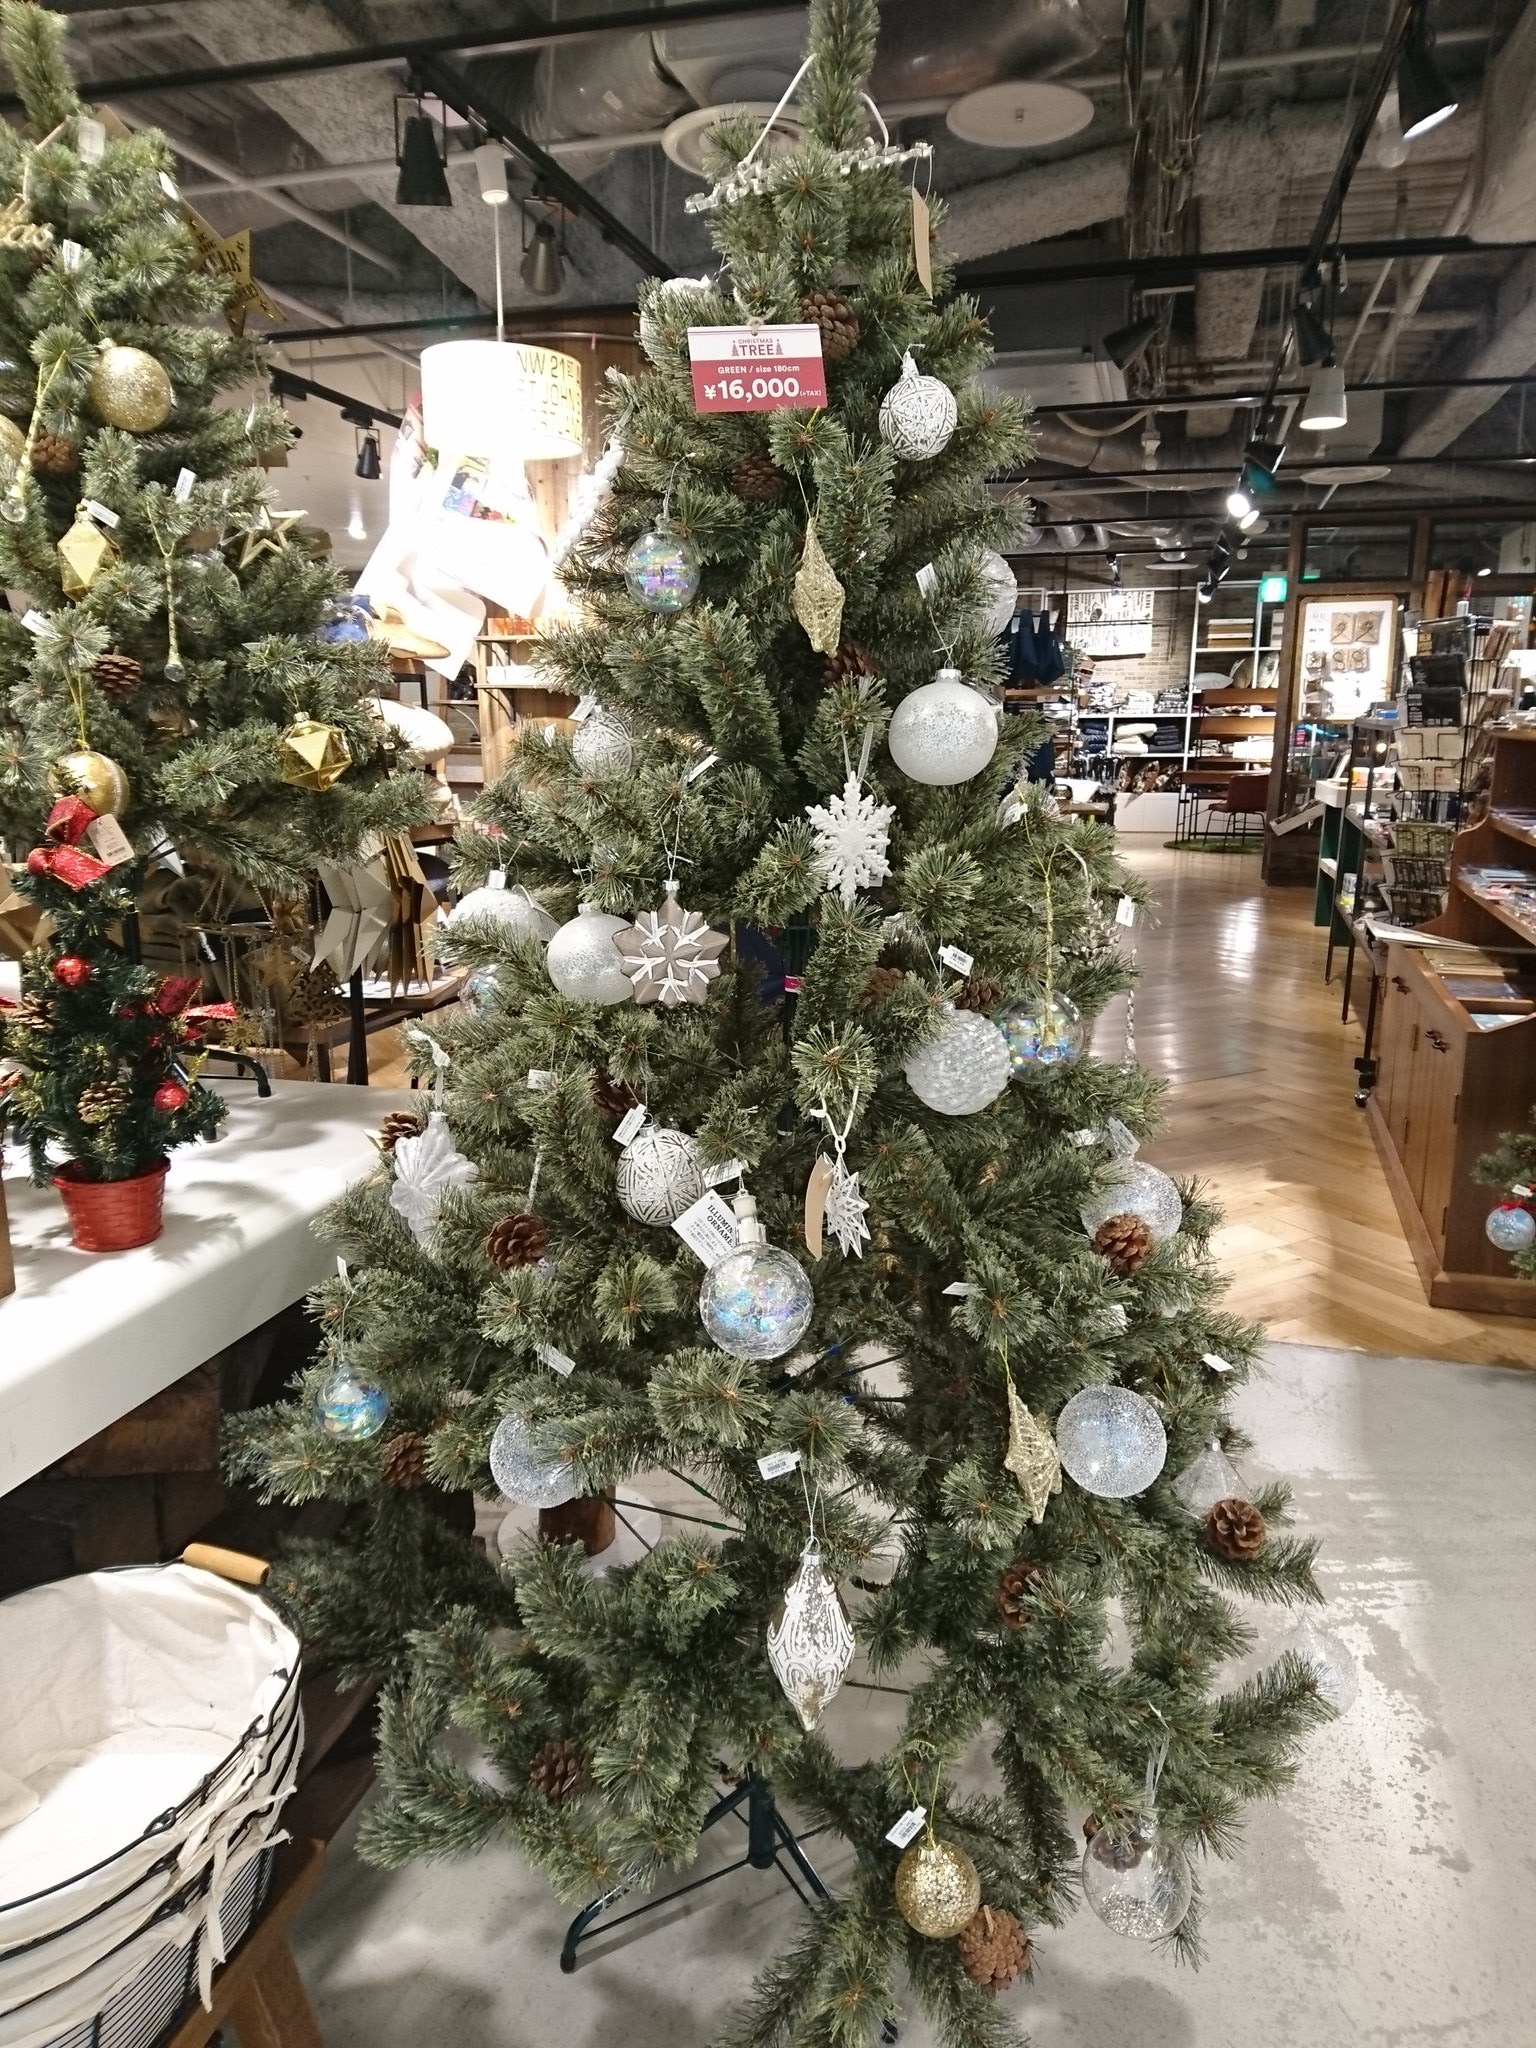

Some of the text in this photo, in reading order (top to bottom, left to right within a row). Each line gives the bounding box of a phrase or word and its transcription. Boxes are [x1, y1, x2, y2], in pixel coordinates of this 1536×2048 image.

[517, 350, 546, 375] NW
[739, 344, 775, 356] TREE
[717, 366, 747, 375] GREEN
[773, 365, 800, 373] 180cm
[703, 377, 800, 403] ¥16,000
[706, 1215, 734, 1248] ORNAME
[707, 1204, 734, 1237] ILLUMIN
